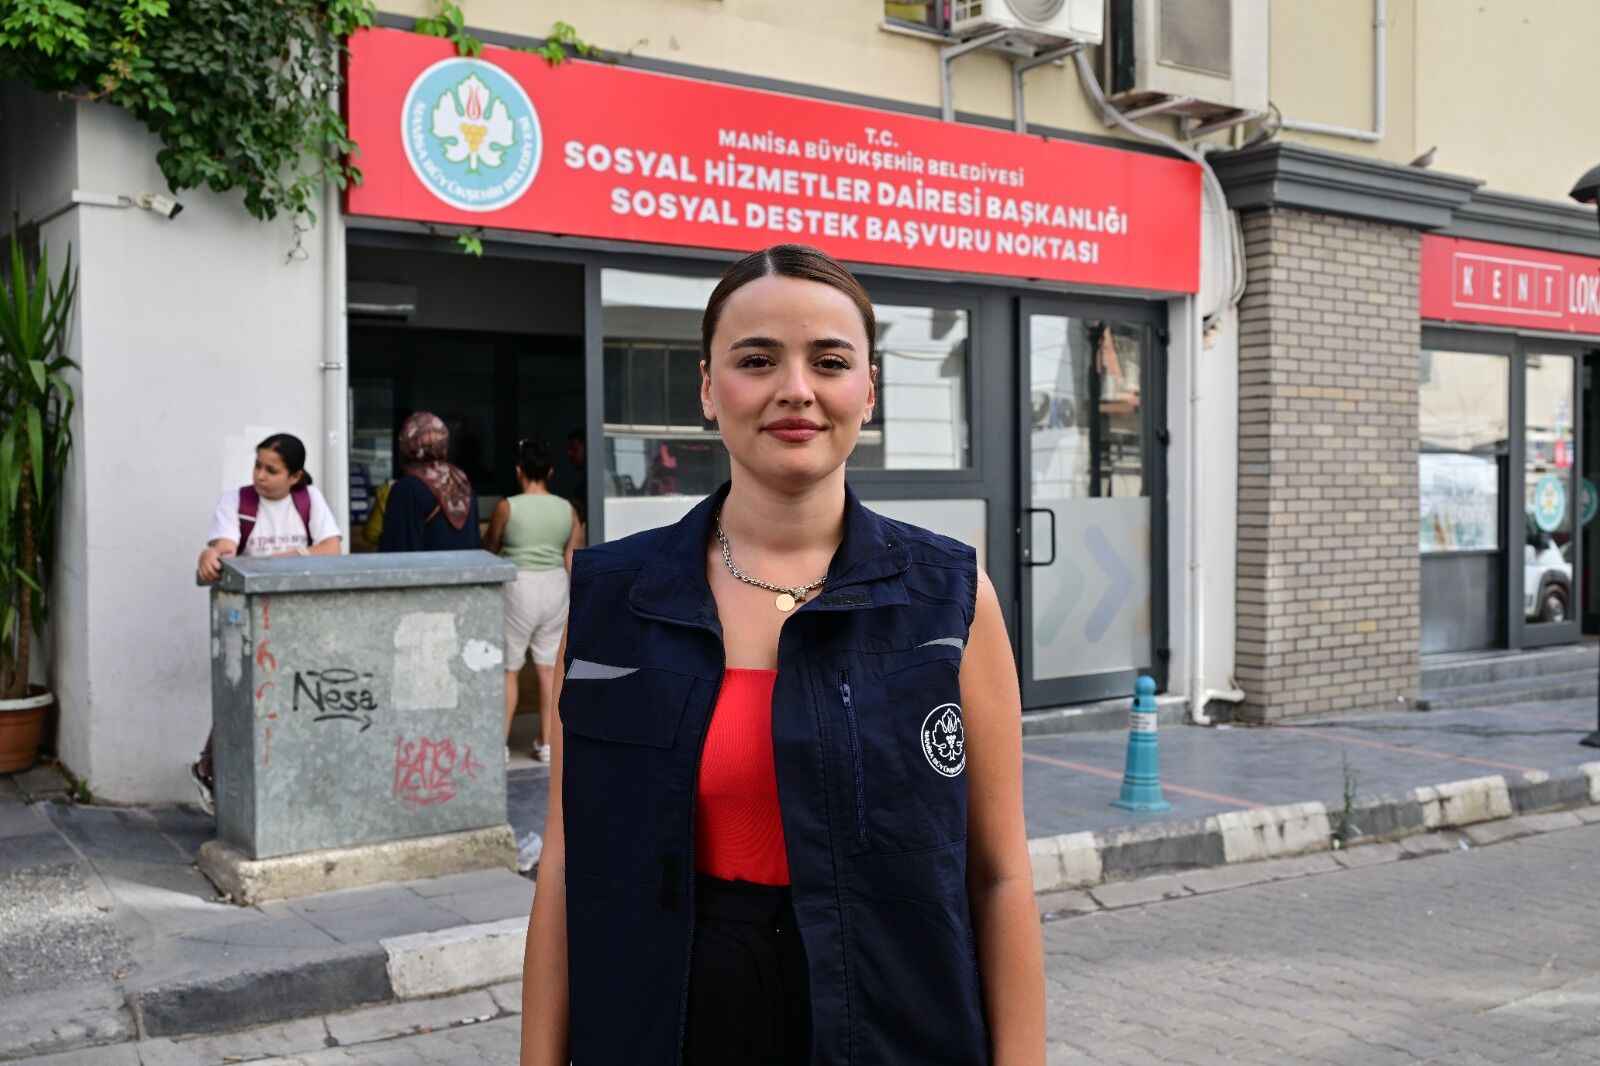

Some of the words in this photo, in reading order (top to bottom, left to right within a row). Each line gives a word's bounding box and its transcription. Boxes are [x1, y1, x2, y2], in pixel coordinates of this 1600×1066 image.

[719, 129, 801, 156] MANİSA
[804, 139, 924, 174] BÜYÜKŞEHİR
[927, 160, 1025, 187] BELEDİYESİ
[865, 127, 898, 147] T.C.
[564, 140, 698, 183] SOSYAL
[705, 153, 871, 204] HİZMETLER
[877, 178, 981, 217] DAİRESİ
[986, 195, 1128, 235] BAŞKANLIĞI
[611, 187, 739, 226] SOSYAL
[746, 202, 859, 239] DESTEK
[865, 216, 991, 253] BAŞVURU
[996, 231, 1099, 264] NOKTASI
